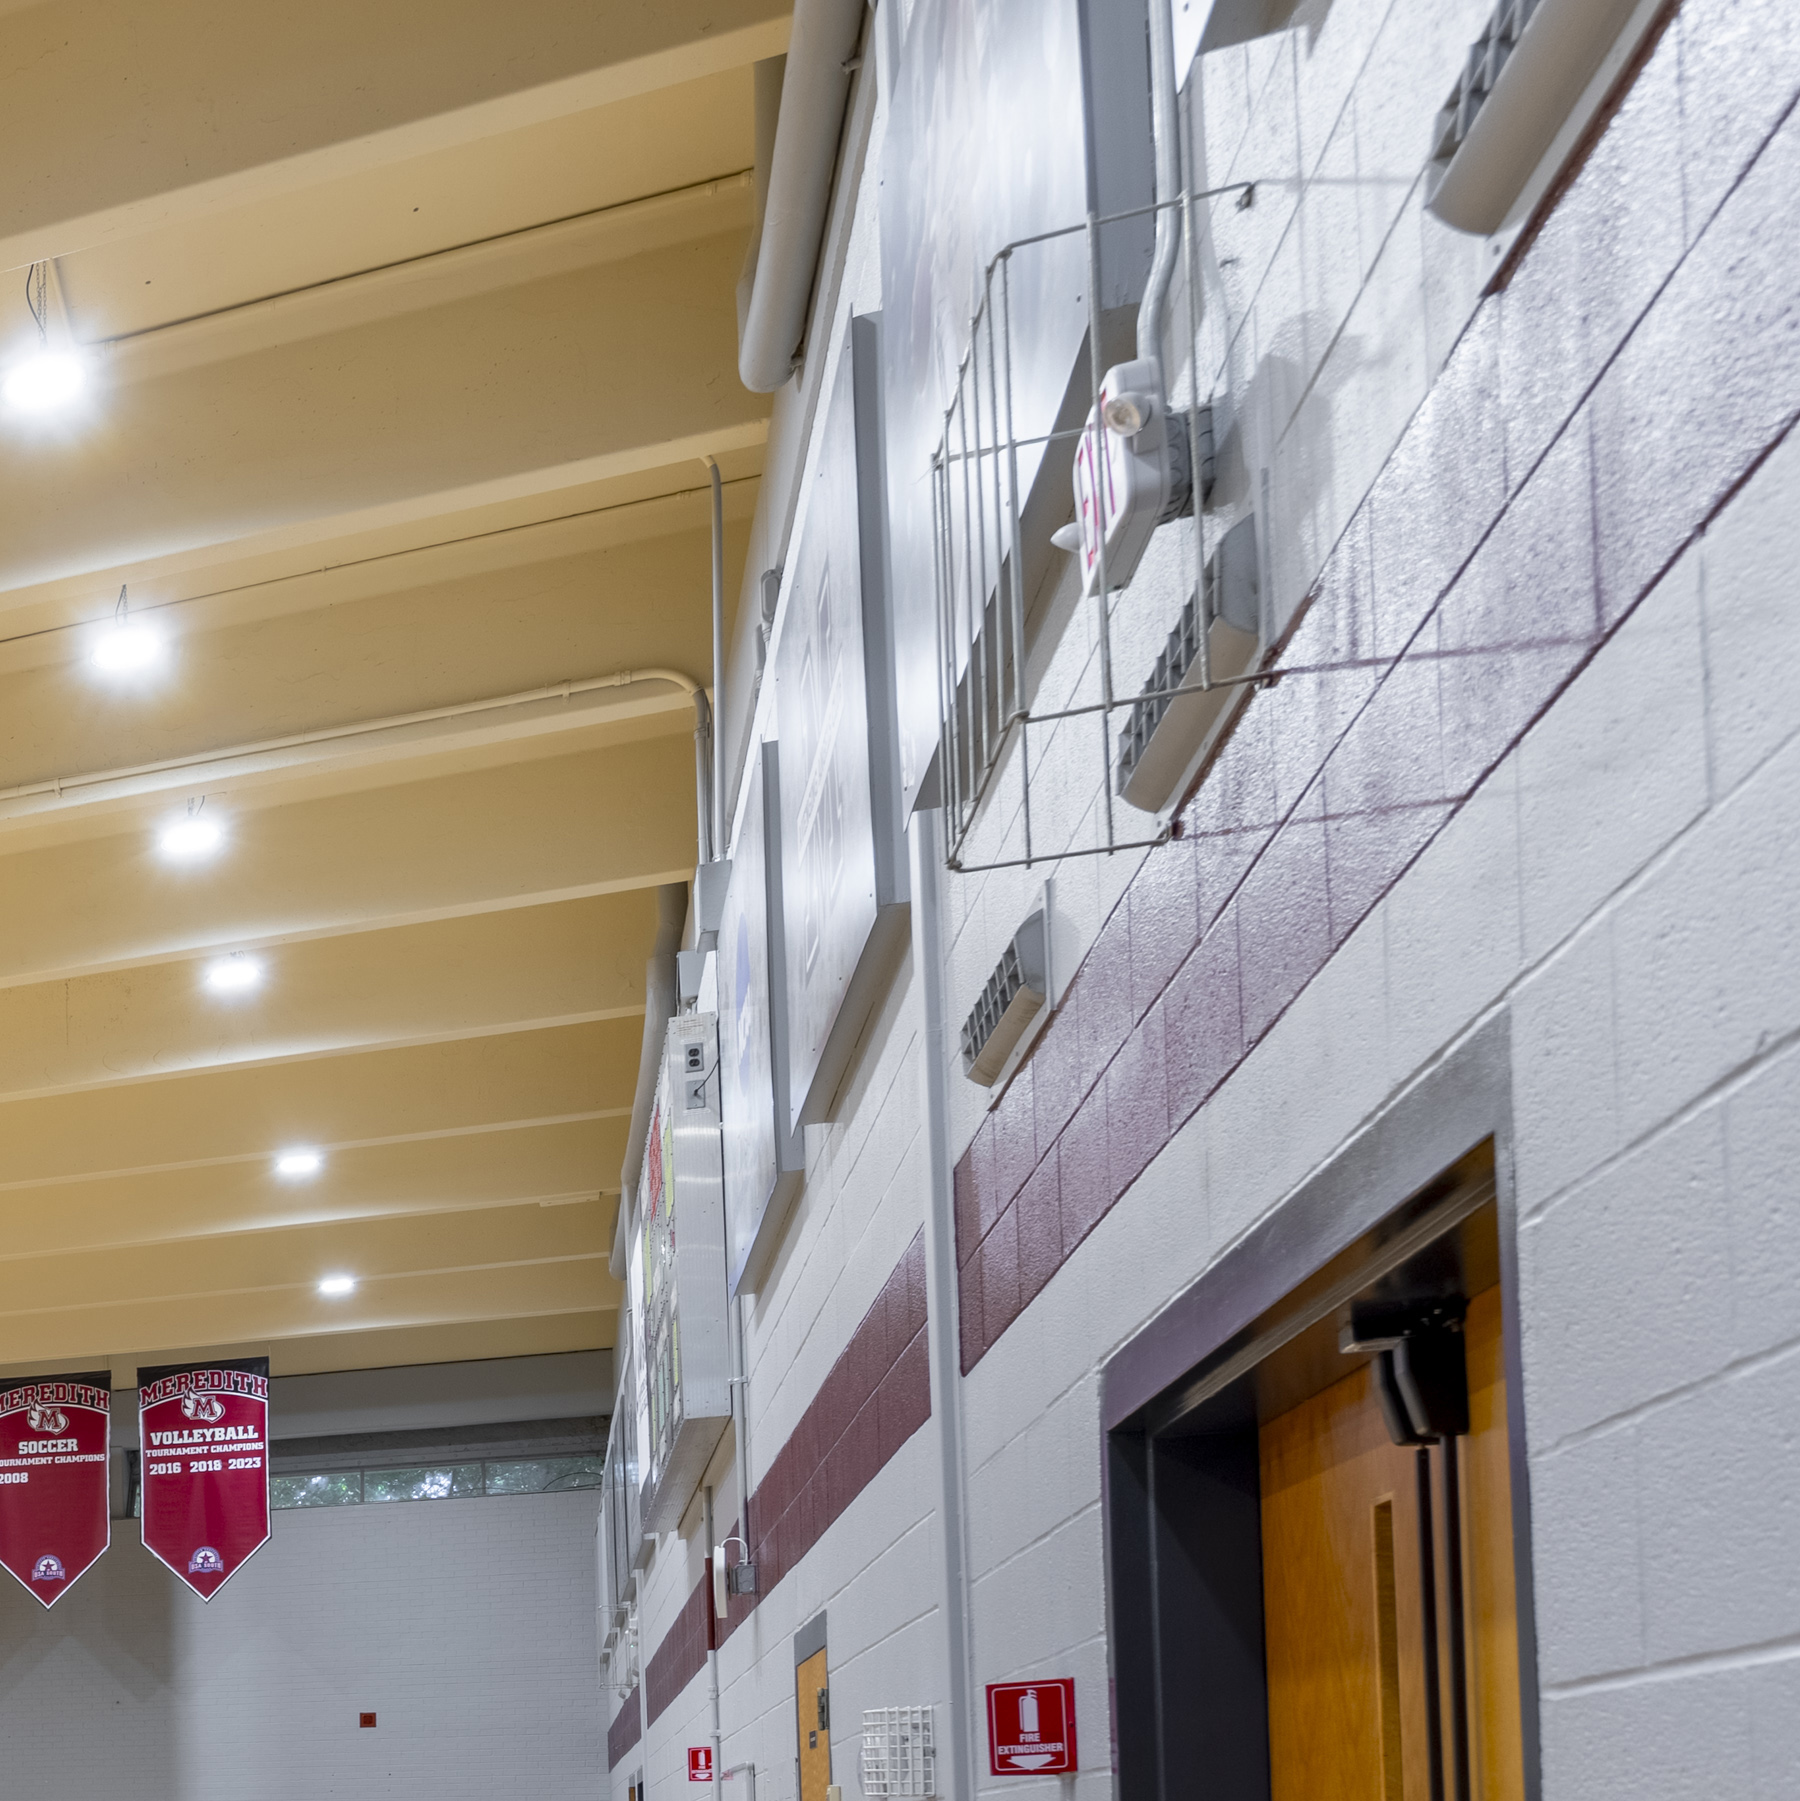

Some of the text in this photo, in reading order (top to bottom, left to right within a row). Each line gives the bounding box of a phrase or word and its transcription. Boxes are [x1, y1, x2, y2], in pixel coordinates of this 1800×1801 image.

[140, 1370, 268, 1408] MEREDITH
[150, 1425, 259, 1446] VOLLEYBALL
[18, 1438, 78, 1454] SOCCER
[146, 1442, 264, 1458] TOURNAMENT CHAMPIONS
[54, 1454, 106, 1464] CHAMPIONS
[149, 1457, 262, 1475] 2016 2018 2023
[1020, 1732, 1040, 1742] FIRE
[998, 1742, 1064, 1755] EXTINGUISHER
